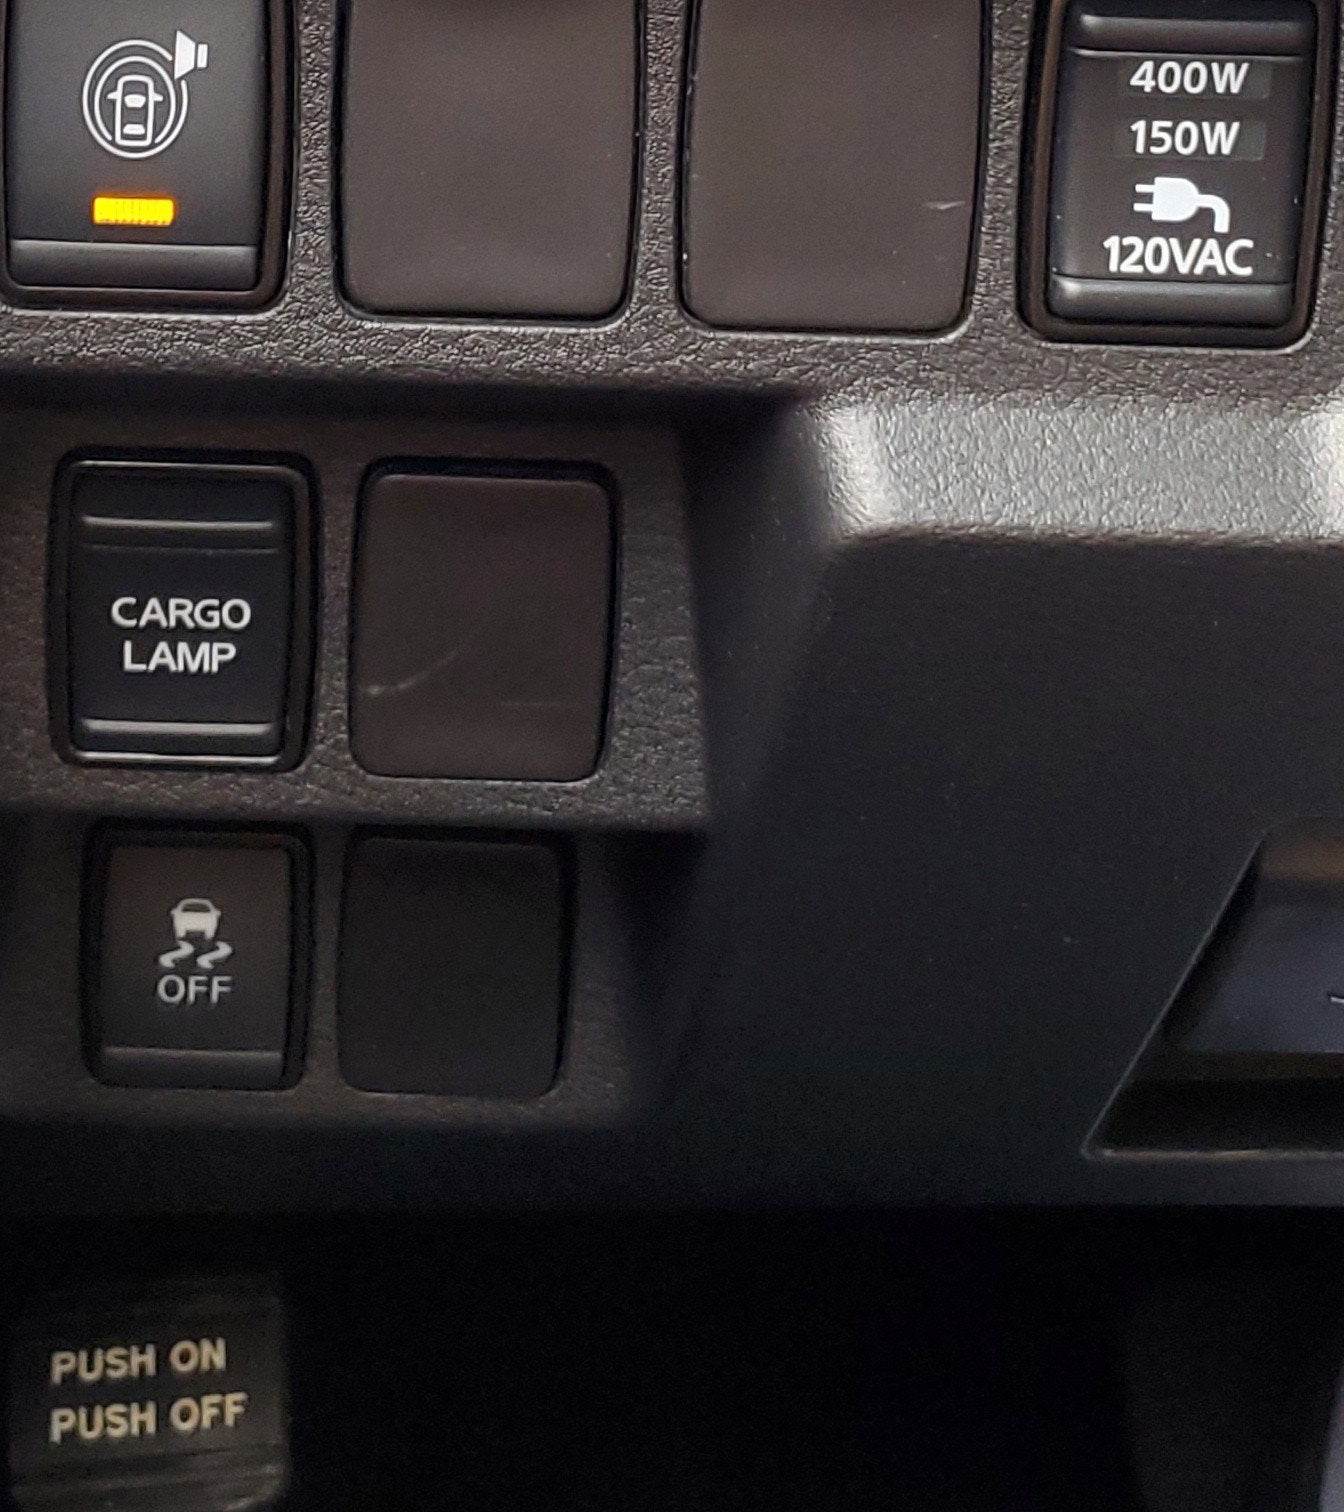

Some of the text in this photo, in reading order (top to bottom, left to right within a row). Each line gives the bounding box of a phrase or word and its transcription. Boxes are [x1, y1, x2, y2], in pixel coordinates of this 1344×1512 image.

[1128, 60, 1250, 95] 400W
[1129, 119, 1241, 156] 150W
[1102, 234, 1255, 277] 120VAC
[110, 596, 252, 630] CARGO
[122, 640, 237, 674] LAMP
[157, 973, 233, 1006] OFF
[50, 1337, 227, 1385] PUSH ON
[49, 1391, 249, 1445] PUSH OFF
